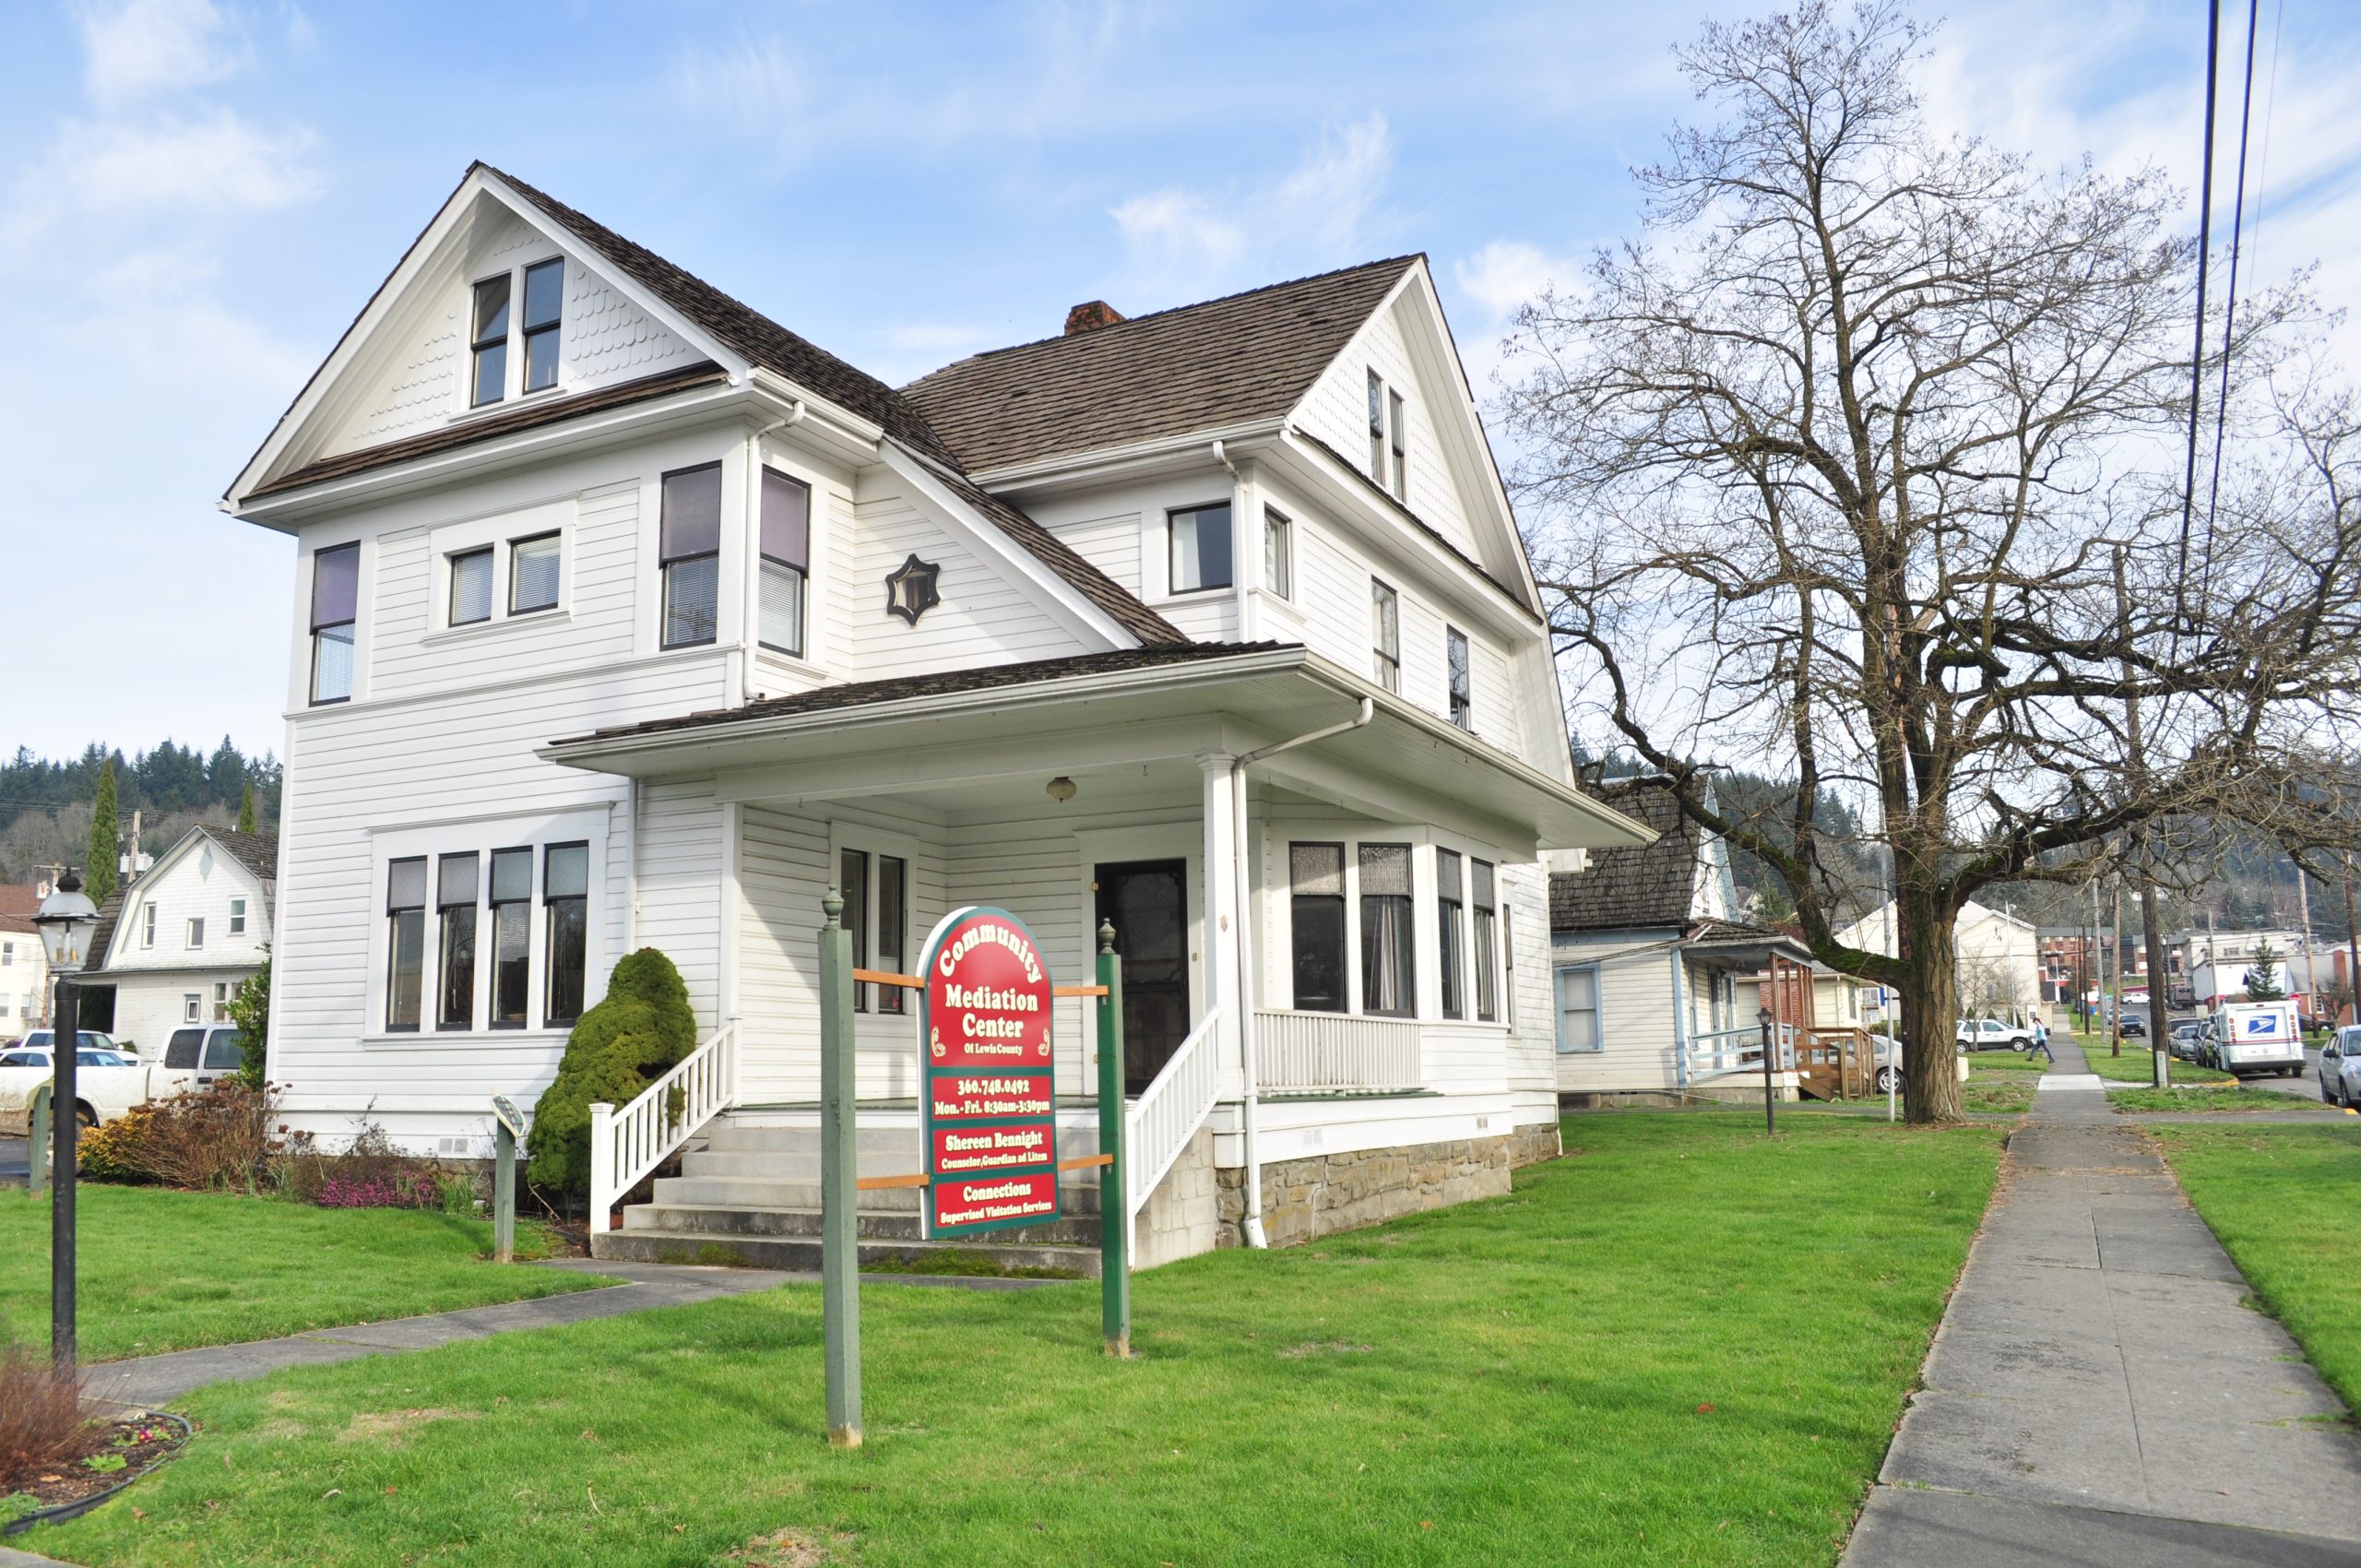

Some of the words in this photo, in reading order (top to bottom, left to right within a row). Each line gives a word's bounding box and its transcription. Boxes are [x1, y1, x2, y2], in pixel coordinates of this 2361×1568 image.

[940, 924, 1042, 984] Community
[944, 983, 1038, 1012] Mediation
[962, 1013, 1024, 1038] Center
[964, 1043, 974, 1054] Of
[975, 1043, 997, 1054] Lewis
[997, 1043, 1023, 1056] County
[957, 1079, 1029, 1096] 360.748.0492
[945, 1134, 992, 1151] Shereen
[994, 1131, 1043, 1149] Bennight
[1017, 1152, 1026, 1163] ad
[1027, 1151, 1048, 1162] Litem
[963, 1182, 1032, 1202] Connections
[941, 1207, 985, 1225] Supervised
[985, 1204, 1022, 1218] Visitation
[1023, 1201, 1052, 1213] Services
